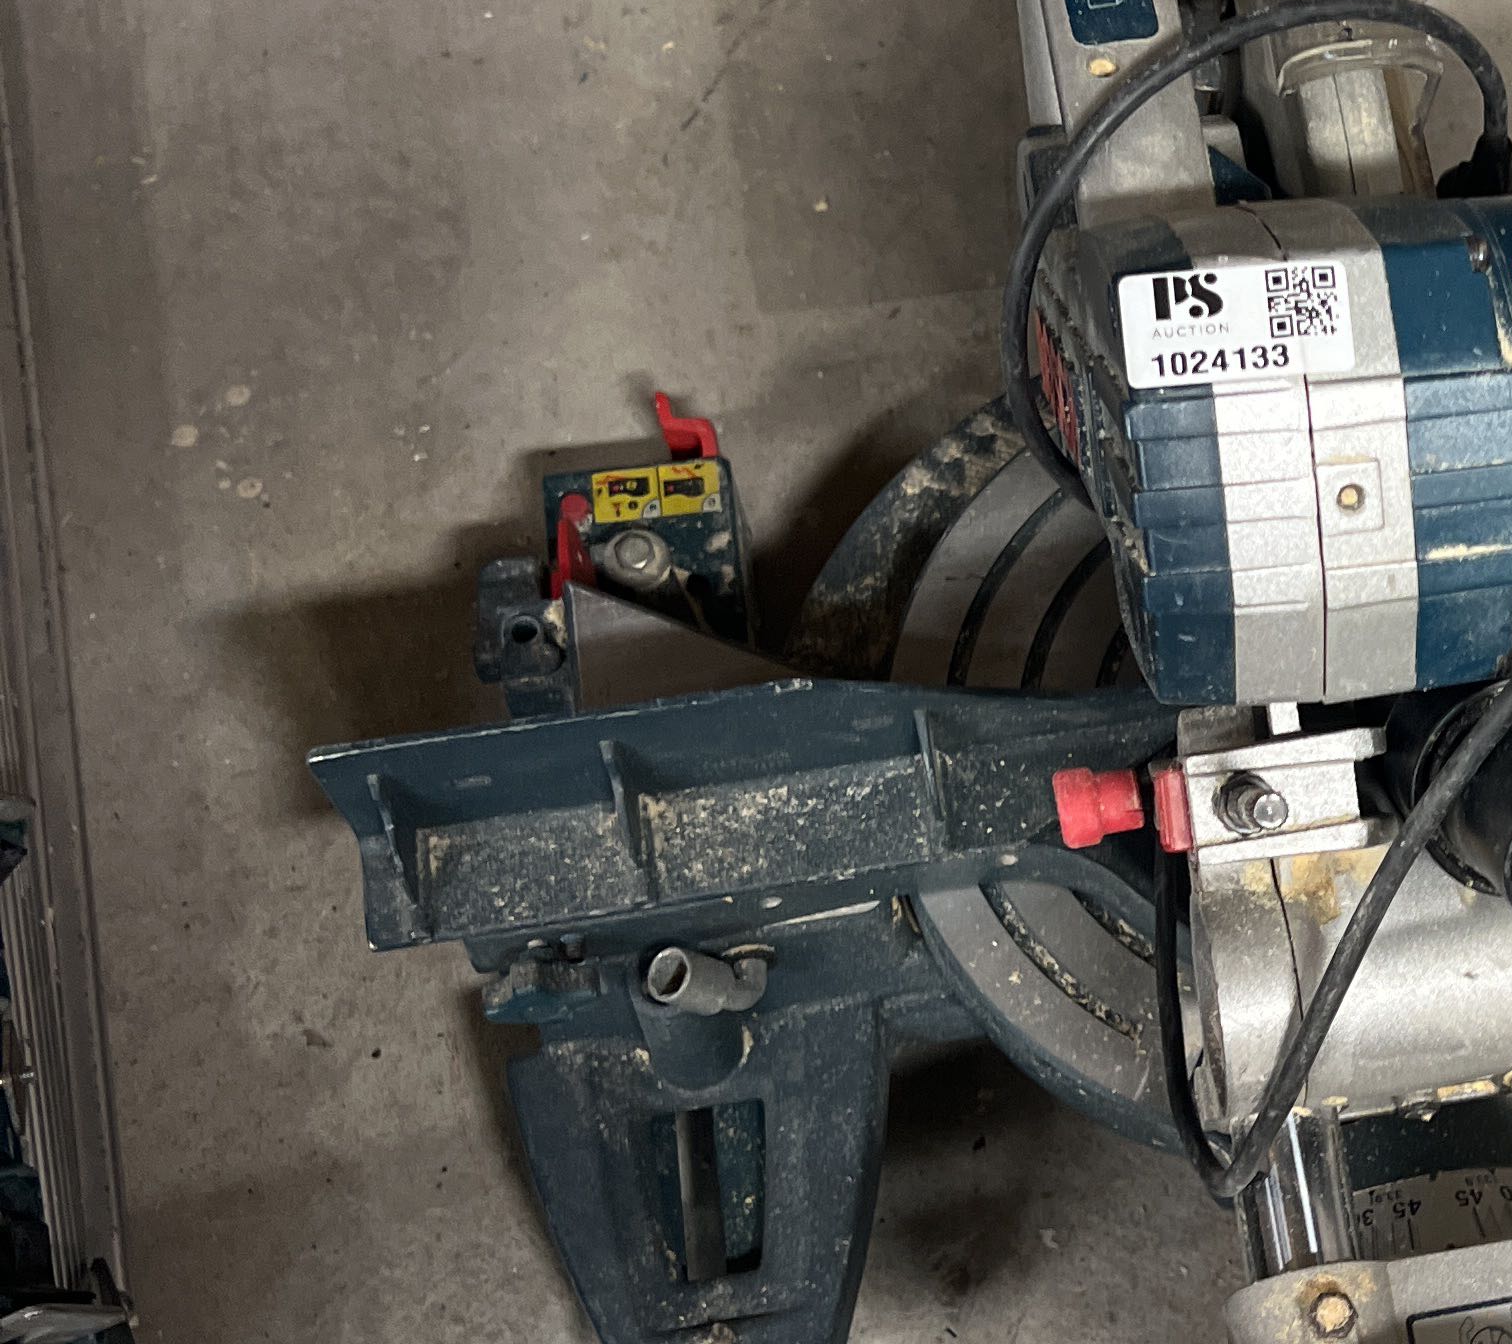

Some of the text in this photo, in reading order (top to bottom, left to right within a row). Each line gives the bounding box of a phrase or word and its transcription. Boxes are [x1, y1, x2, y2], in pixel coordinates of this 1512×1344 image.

[1152, 272, 1224, 321] PS
[1152, 323, 1230, 340] AUCTION
[1151, 343, 1291, 377] 1024133
[1454, 1188, 1484, 1207] 45
[1392, 1199, 1422, 1219] 45
